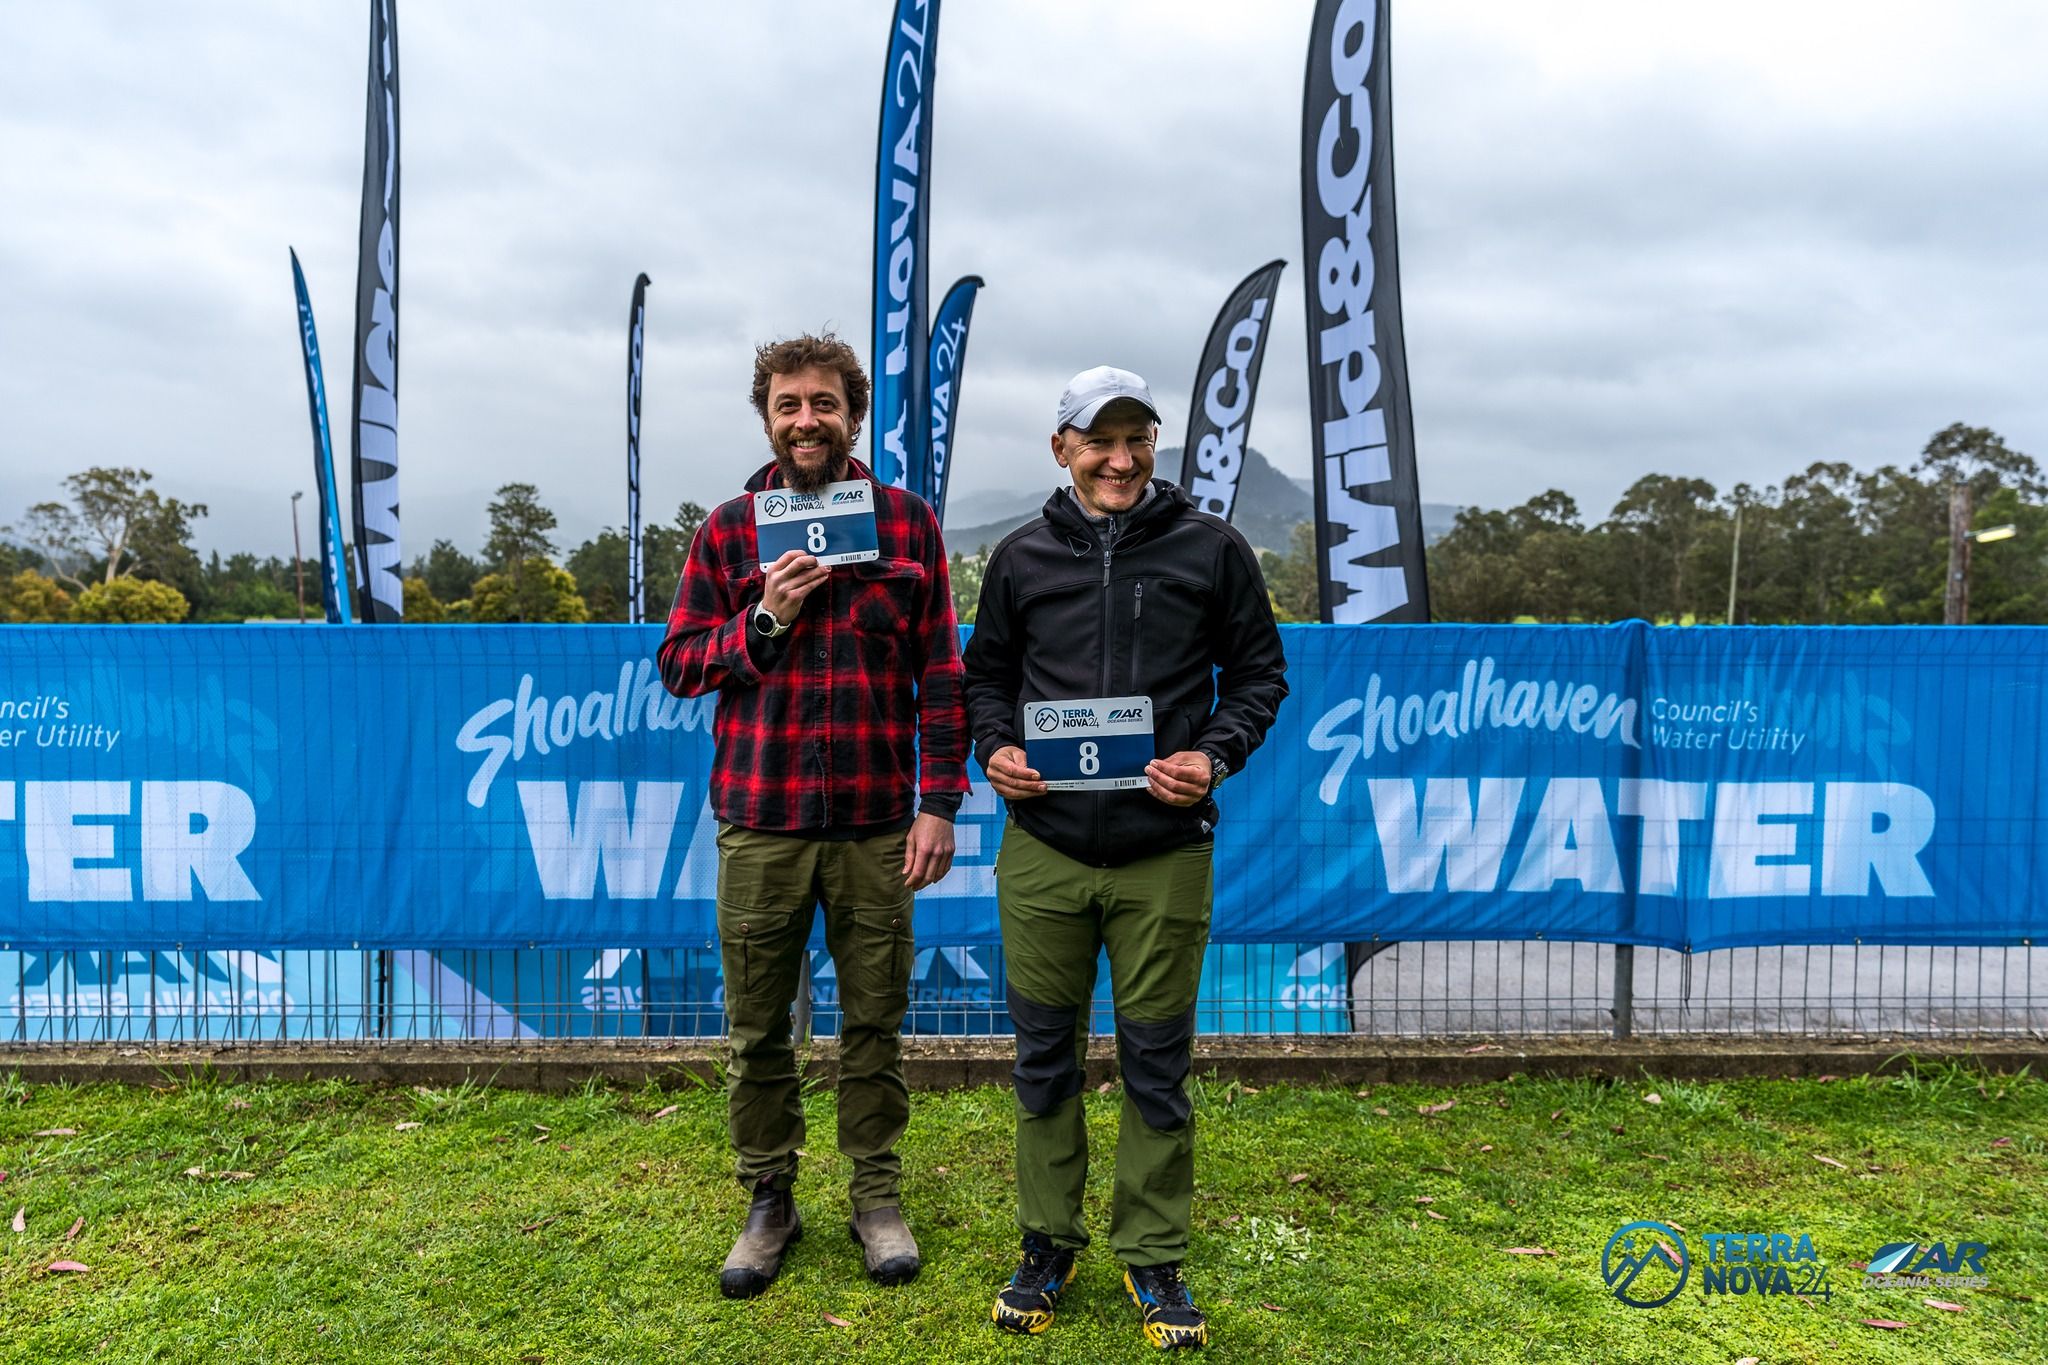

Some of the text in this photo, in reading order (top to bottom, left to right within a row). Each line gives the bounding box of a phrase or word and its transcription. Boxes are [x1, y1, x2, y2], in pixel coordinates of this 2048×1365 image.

[789, 493, 820, 504] TERRA
[843, 490, 864, 501] AR
[806, 522, 827, 553] 8
[1061, 708, 1095, 719] TERRA
[1120, 708, 1143, 719] AR
[1652, 697, 1759, 723] Council's
[36, 723, 121, 752] Utility
[455, 657, 717, 809] Shoalha
[1307, 656, 1643, 805] Shoalhaven
[1652, 724, 1805, 755] Water Utility
[1079, 741, 1100, 776] 8
[0, 780, 263, 902] ER
[1367, 777, 1936, 899] WATER
